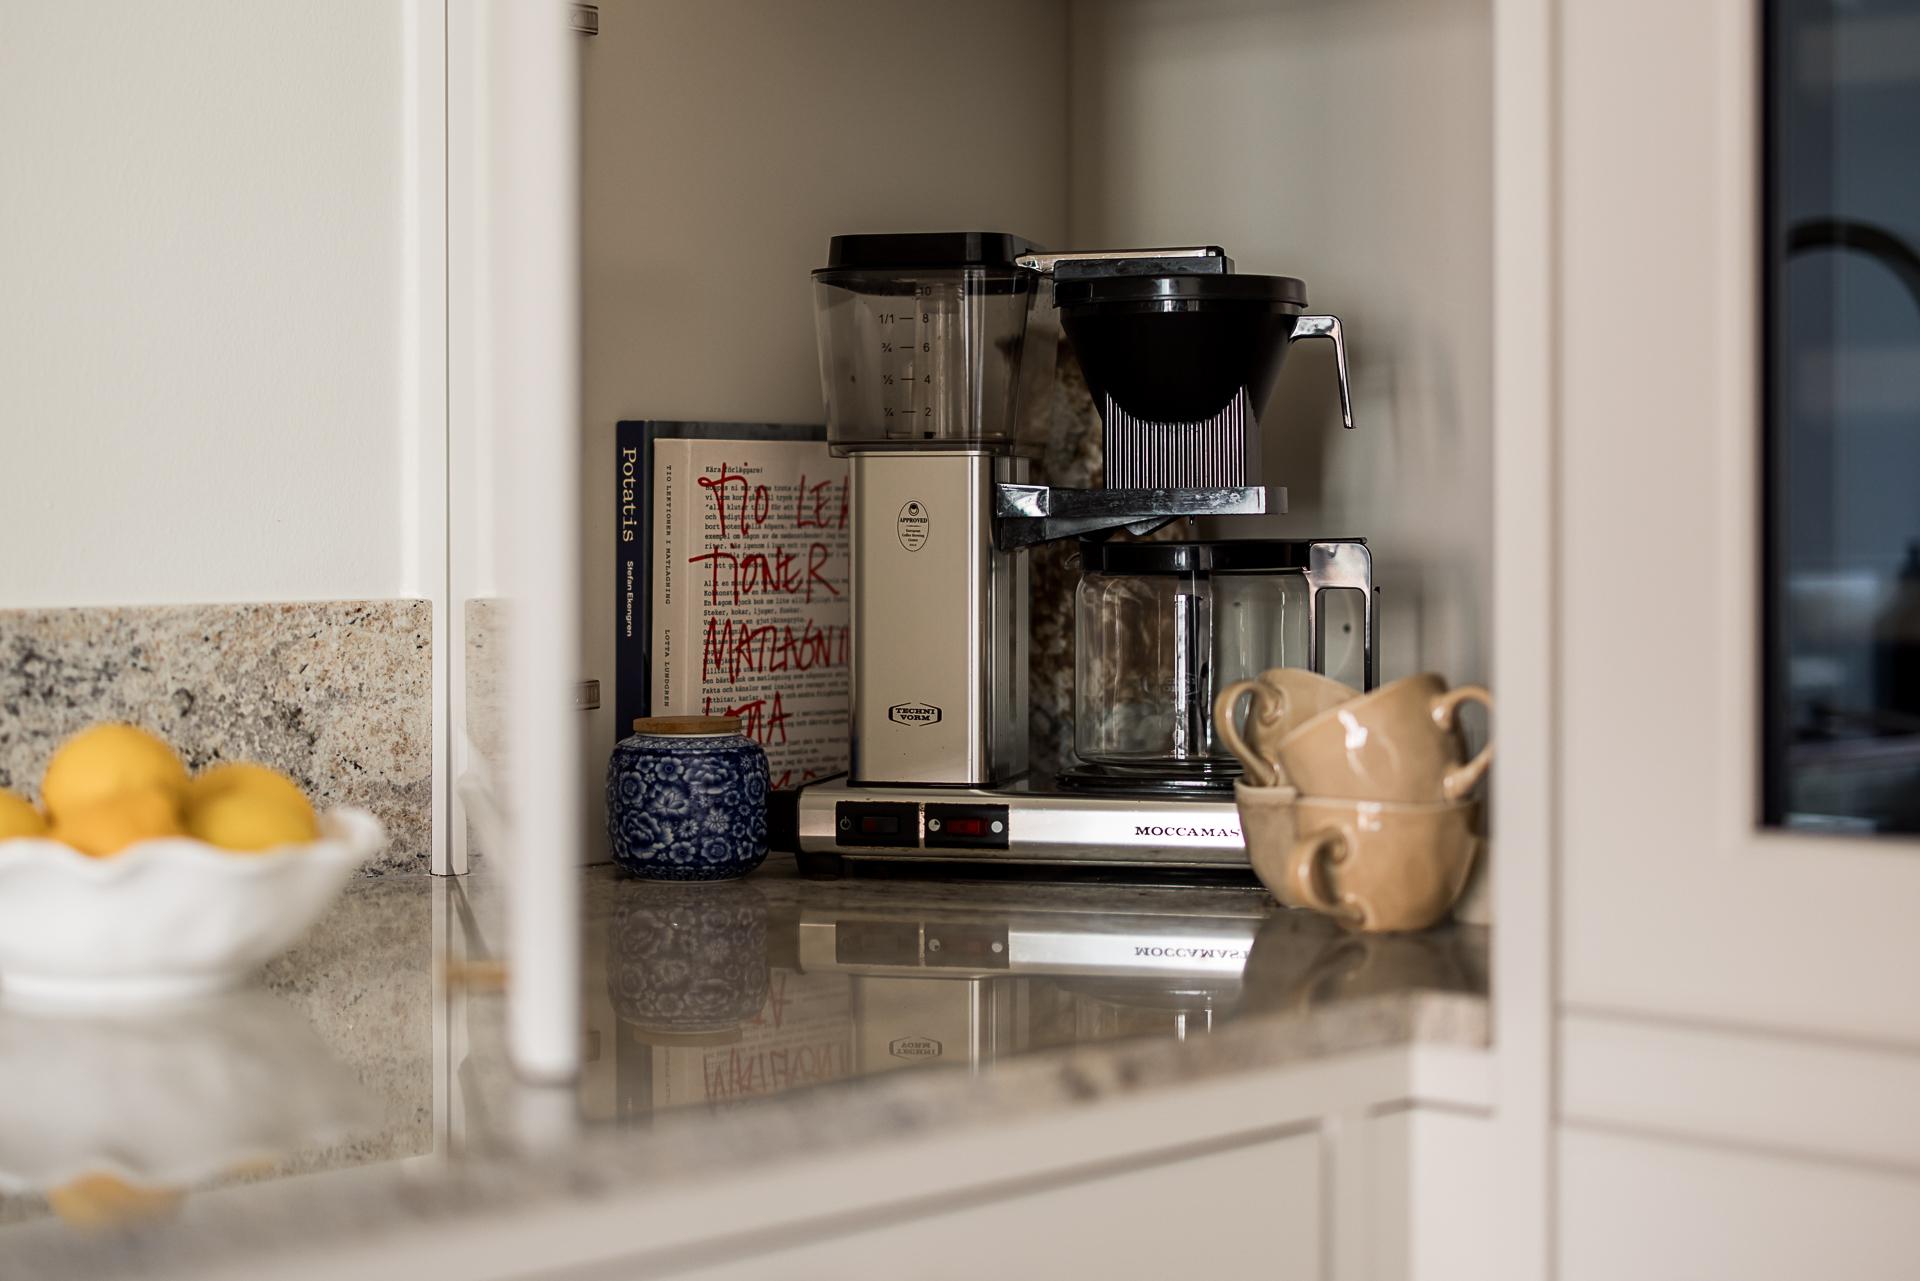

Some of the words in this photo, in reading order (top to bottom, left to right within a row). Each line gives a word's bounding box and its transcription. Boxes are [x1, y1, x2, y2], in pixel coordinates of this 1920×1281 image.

[879, 314, 894, 324] 1/1
[922, 313, 929, 324] 8
[923, 342, 930, 352] 6
[924, 374, 930, 384] 4
[925, 407, 932, 416] 2
[622, 447, 637, 542] Potatis
[625, 592, 634, 637] Ekengren
[702, 616, 848, 684] MATLAGNI
[1135, 826, 1240, 837] MOCCAMAS
